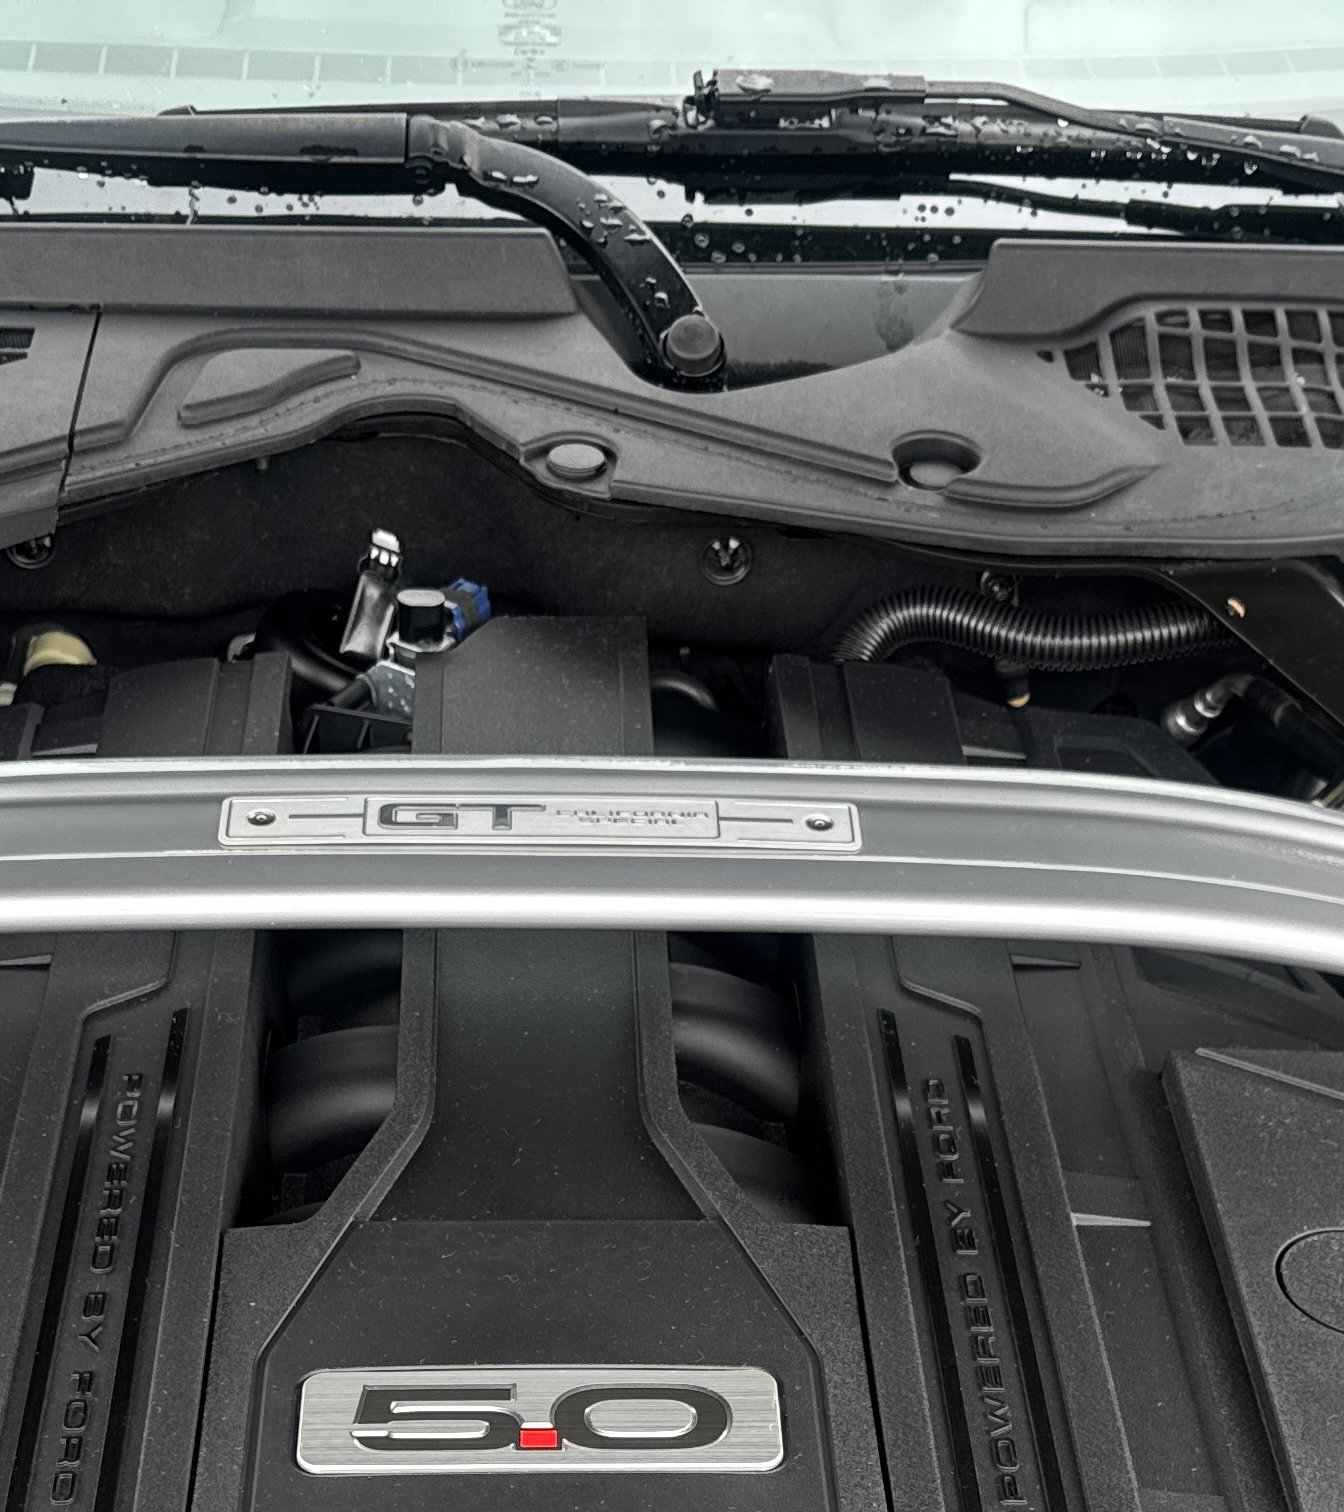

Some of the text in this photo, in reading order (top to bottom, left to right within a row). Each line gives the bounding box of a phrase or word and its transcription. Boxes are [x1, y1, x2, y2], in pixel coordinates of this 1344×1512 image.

[377, 803, 546, 831] GT
[51, 1073, 145, 1505] POWERED BY FORD
[924, 1078, 1027, 1505] POWERED BY FORD
[350, 1383, 734, 1451] 5.0
